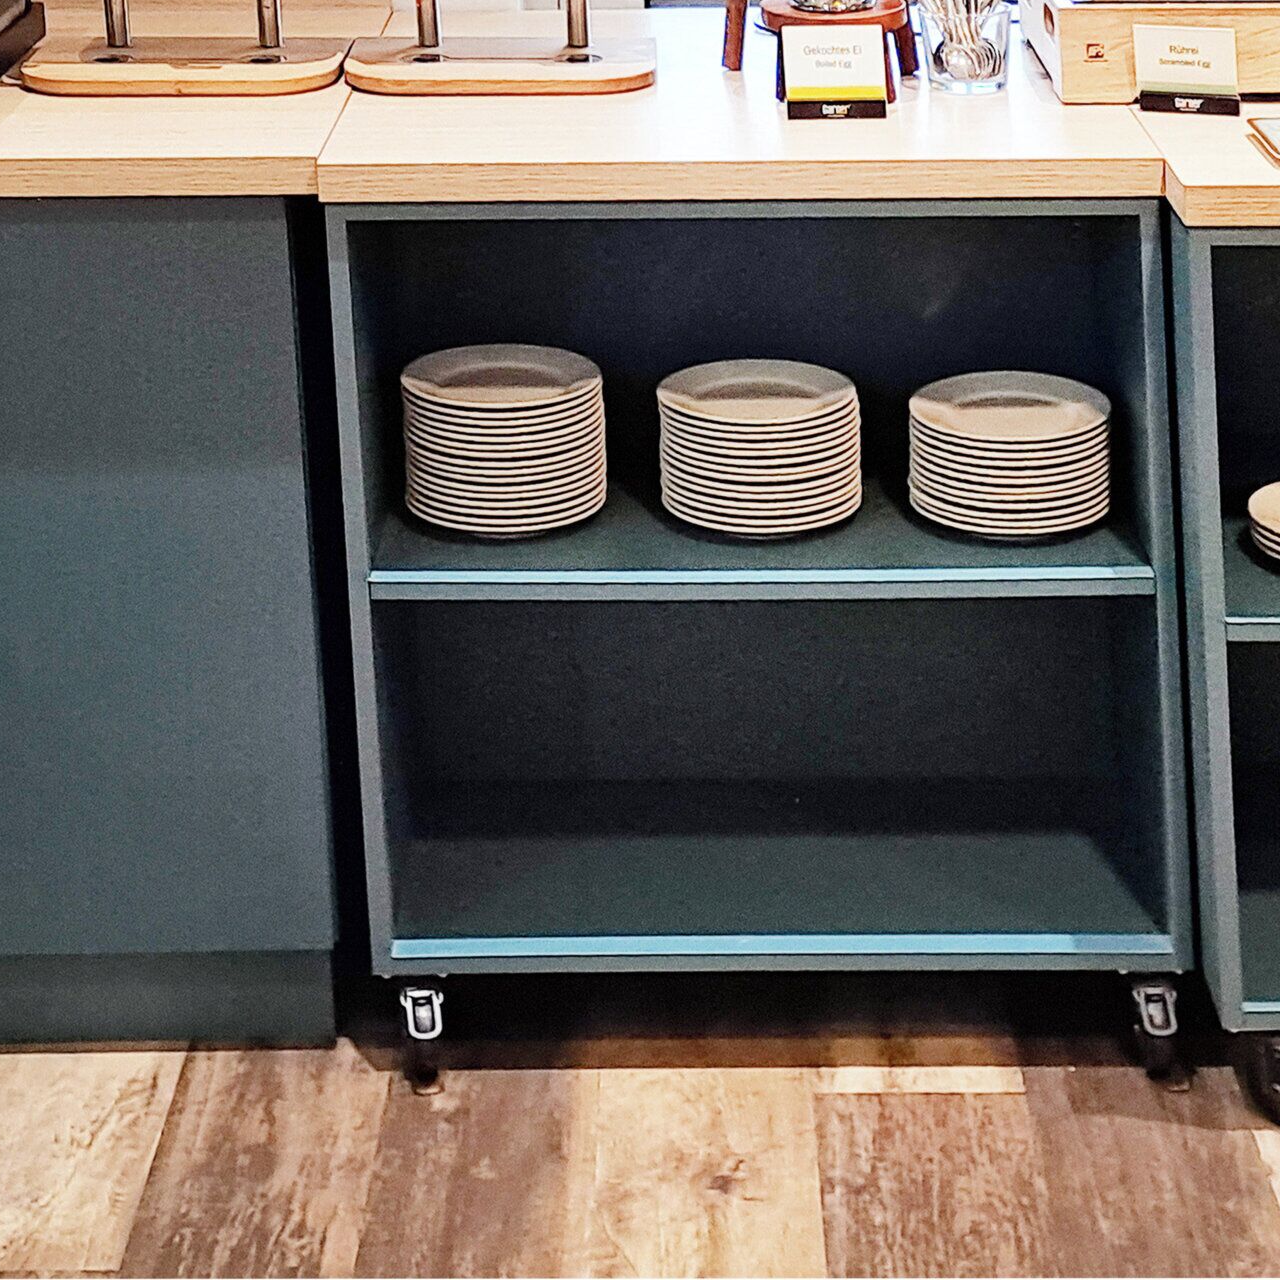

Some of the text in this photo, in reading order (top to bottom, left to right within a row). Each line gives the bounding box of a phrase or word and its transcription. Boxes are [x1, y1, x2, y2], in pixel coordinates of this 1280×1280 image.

[803, 45, 862, 55] Gekochtes Ei
[1169, 43, 1199, 54] Rührei
